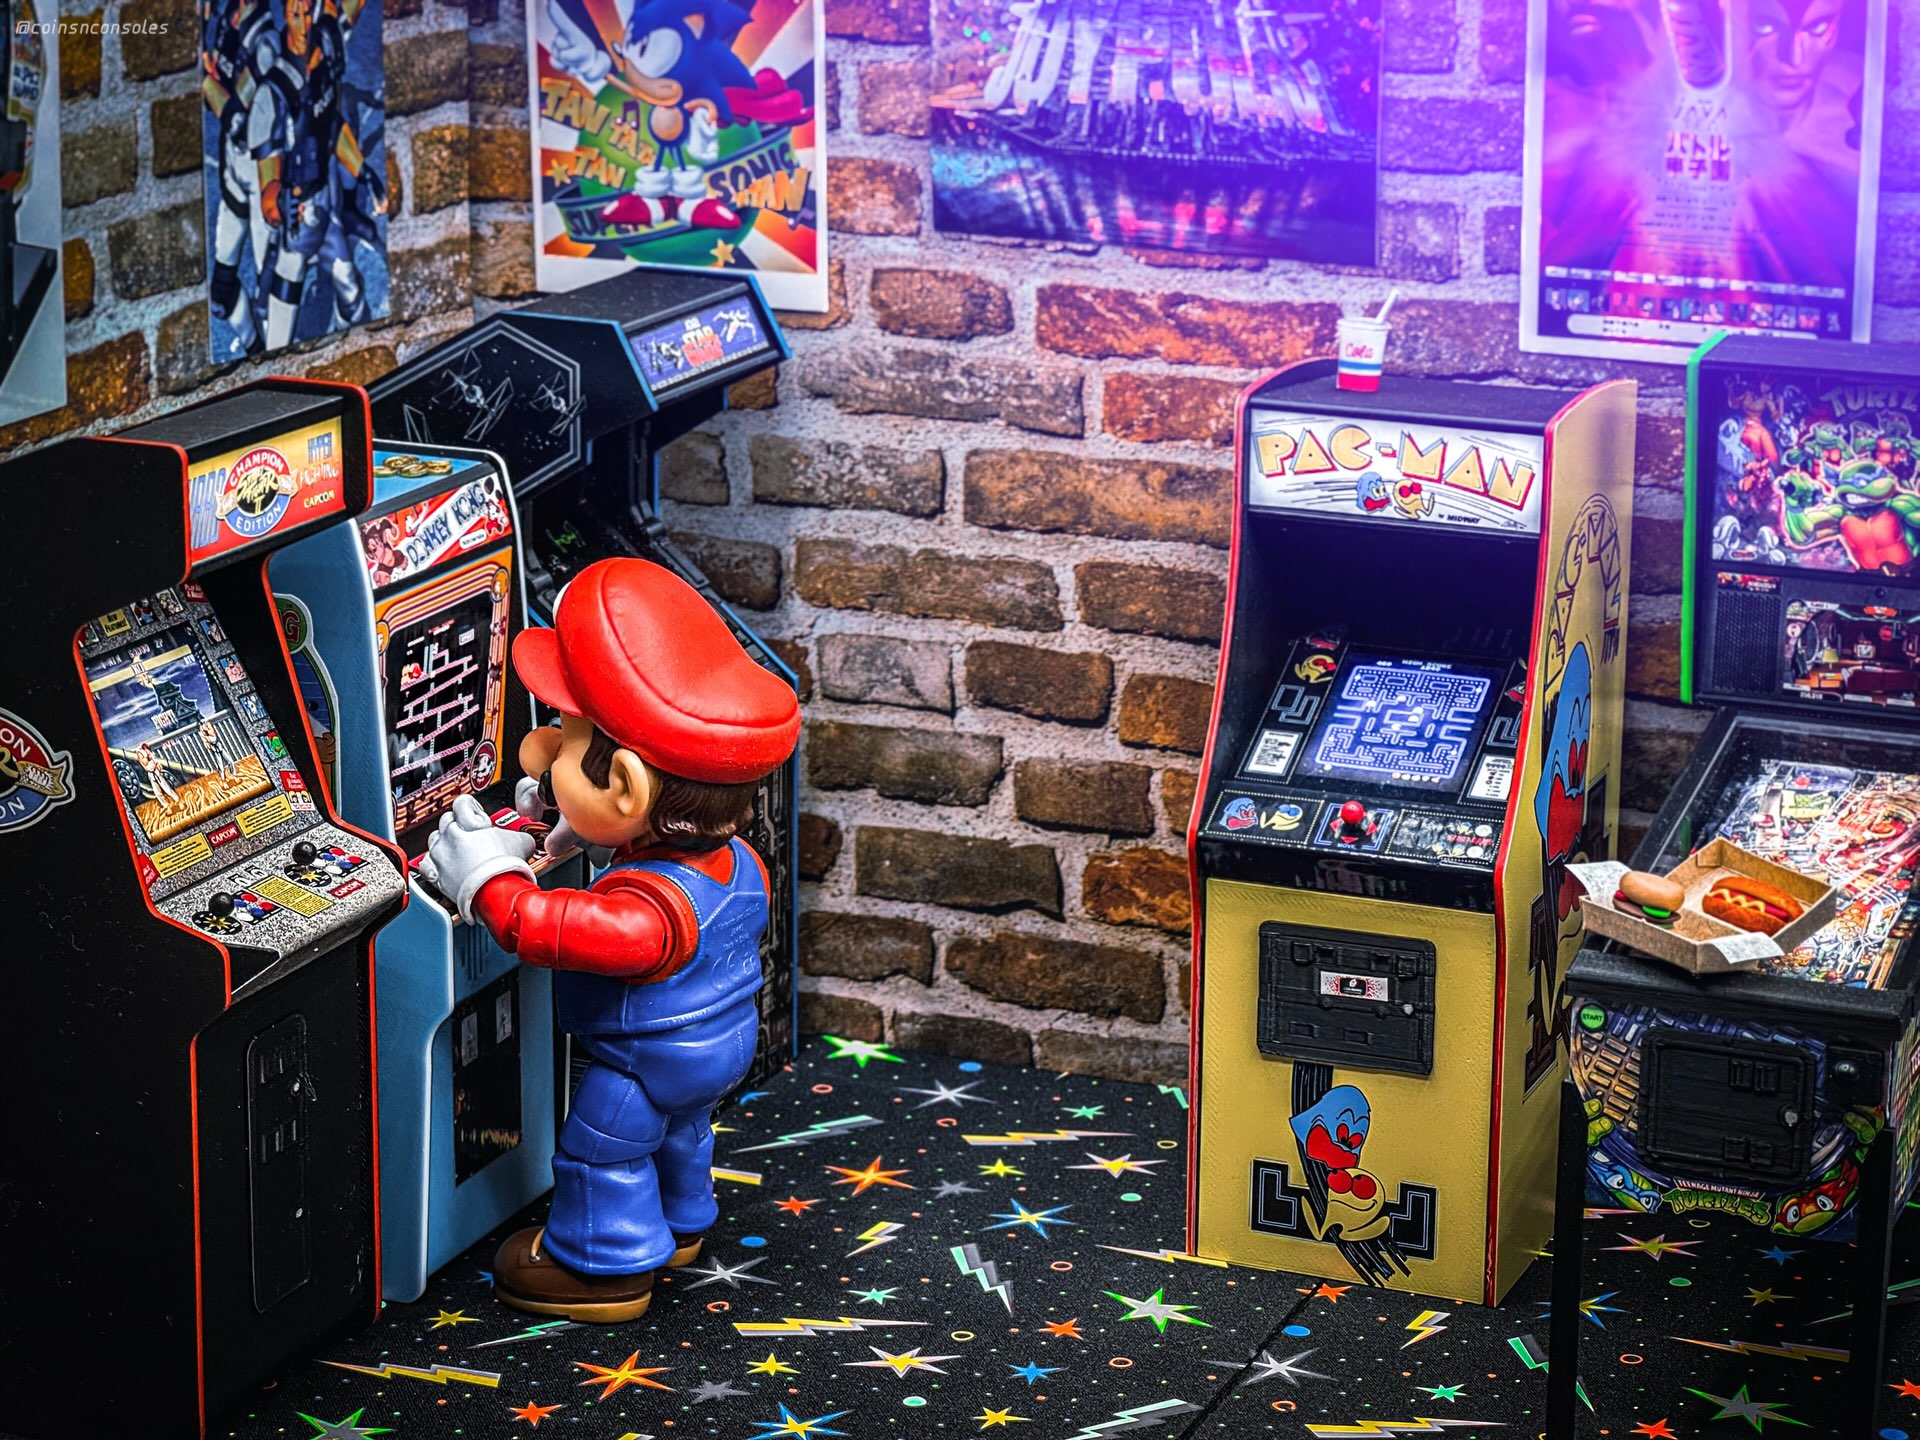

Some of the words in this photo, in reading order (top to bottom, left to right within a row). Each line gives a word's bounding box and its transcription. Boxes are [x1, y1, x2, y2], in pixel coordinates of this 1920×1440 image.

[541, 76, 611, 137] TAN
[574, 145, 628, 190] TAN
[708, 141, 796, 204] SONIC
[229, 452, 284, 487] CHAMPION
[1251, 421, 1536, 512] PAC-MAN
[303, 488, 335, 509] CAPCOM
[235, 503, 283, 533] EDITION
[405, 508, 452, 568] DONKEY
[451, 483, 487, 526] KONG
[1447, 514, 1481, 524] MIDWAY
[210, 827, 239, 844] CAPCOM
[1337, 842, 1358, 850] MOVE
[1582, 1013, 1604, 1022] START
[1677, 1179, 1710, 1191] TEENAGE
[1710, 1185, 1737, 1195] MUTANT
[1737, 1189, 1760, 1198] NINJA
[1662, 1188, 1772, 1226] TURTLES
